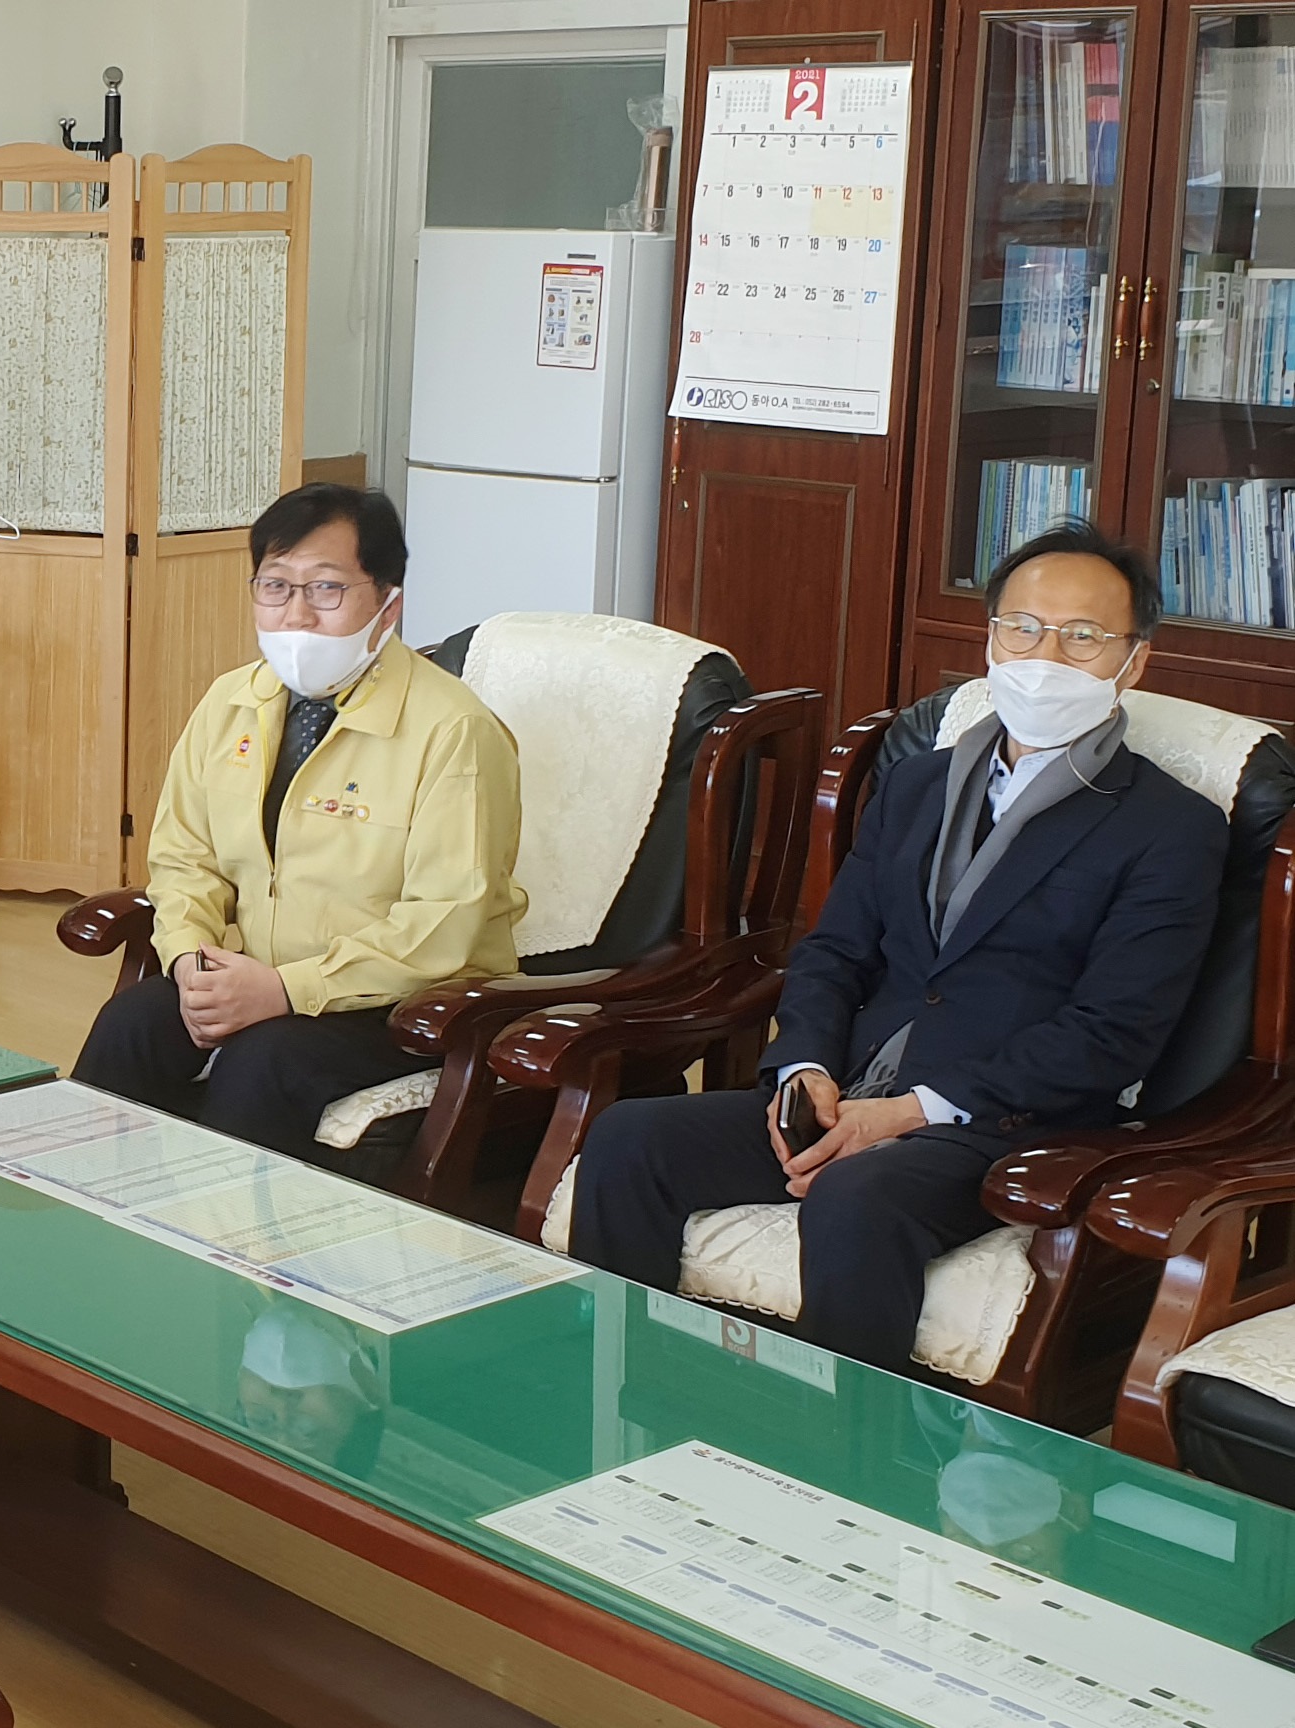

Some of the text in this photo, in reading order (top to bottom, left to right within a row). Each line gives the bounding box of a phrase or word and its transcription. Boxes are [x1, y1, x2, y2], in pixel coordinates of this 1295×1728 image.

[795, 70, 821, 80] 2021
[791, 81, 819, 120] 2
[892, 83, 897, 92] 3
[731, 136, 883, 148] 1 2 3 4 5 6
[703, 184, 883, 201] 7 8 9 10 11 12 13
[699, 234, 881, 252] 14 15 16 17 18 19 20
[694, 282, 878, 304] 21 22 23 24 25 26 27
[689, 331, 701, 343] 28
[703, 388, 748, 411] RISO
[751, 393, 769, 408] 동아
